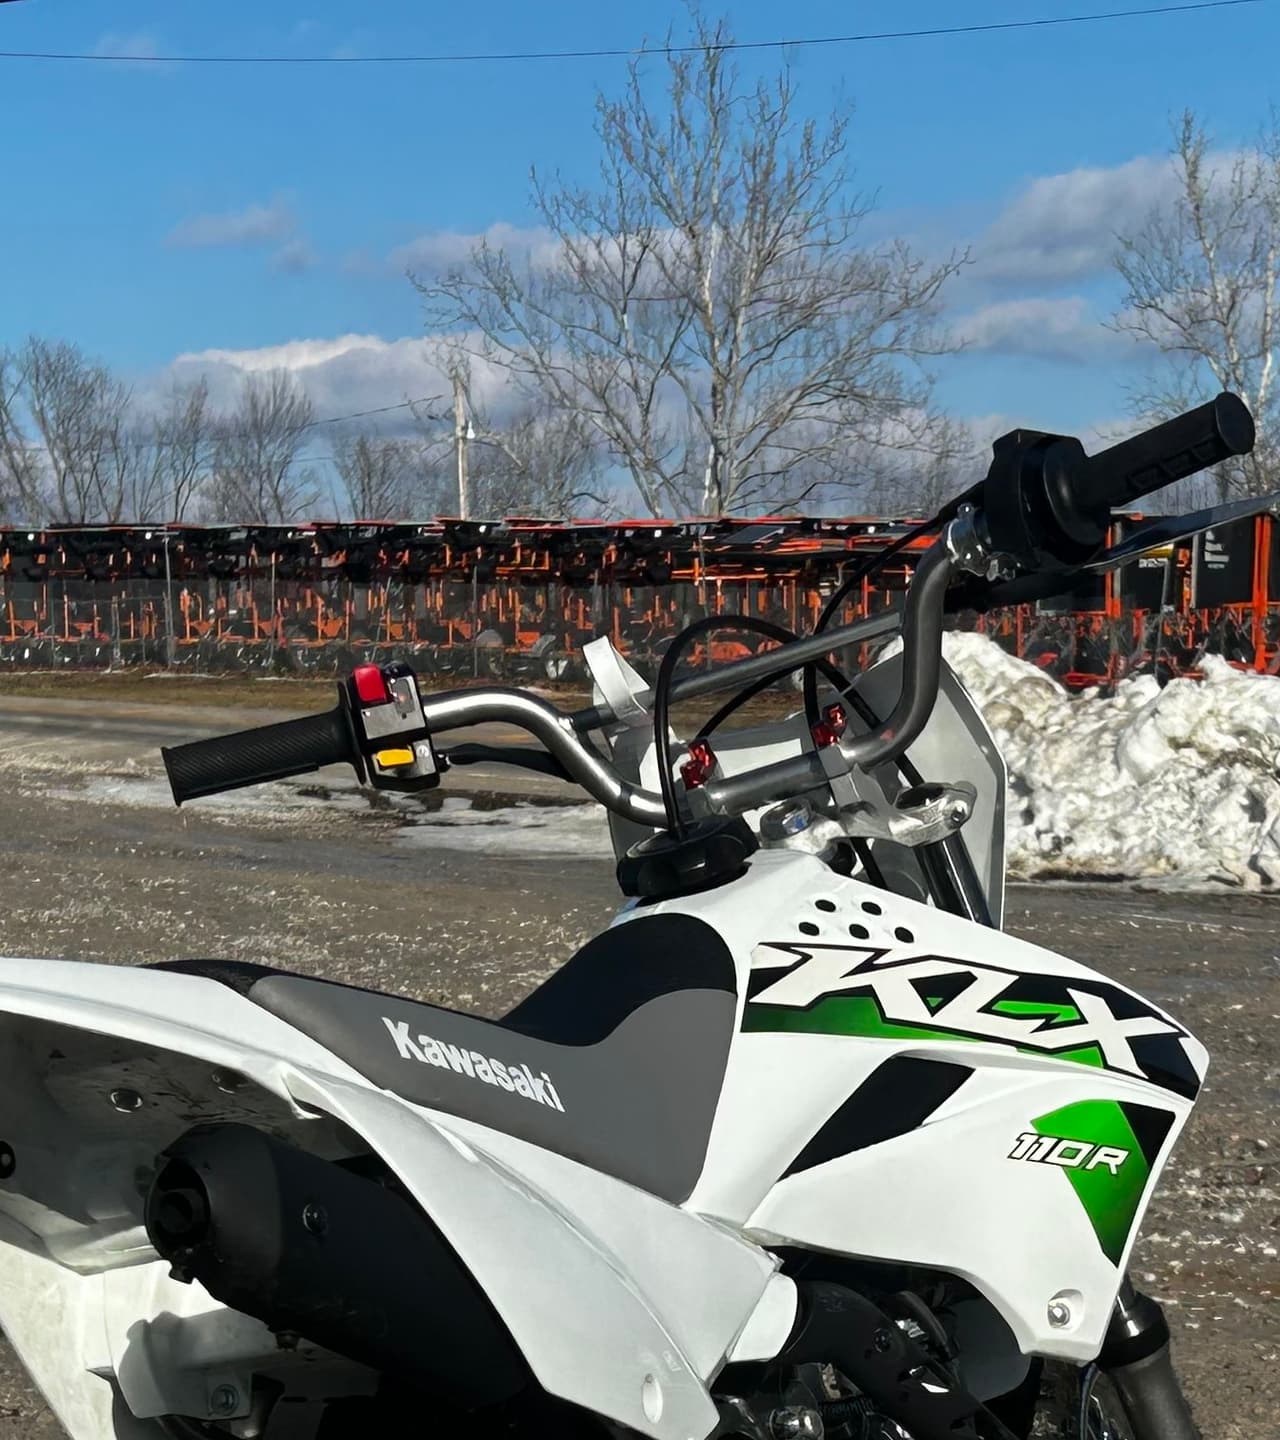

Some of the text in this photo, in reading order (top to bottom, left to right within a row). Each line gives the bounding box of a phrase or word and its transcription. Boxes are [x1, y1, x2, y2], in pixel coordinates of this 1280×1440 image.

[748, 942, 1186, 1080] KLX
[382, 1016, 566, 1113] Kawasaki
[1007, 1132, 1130, 1175] 110R
